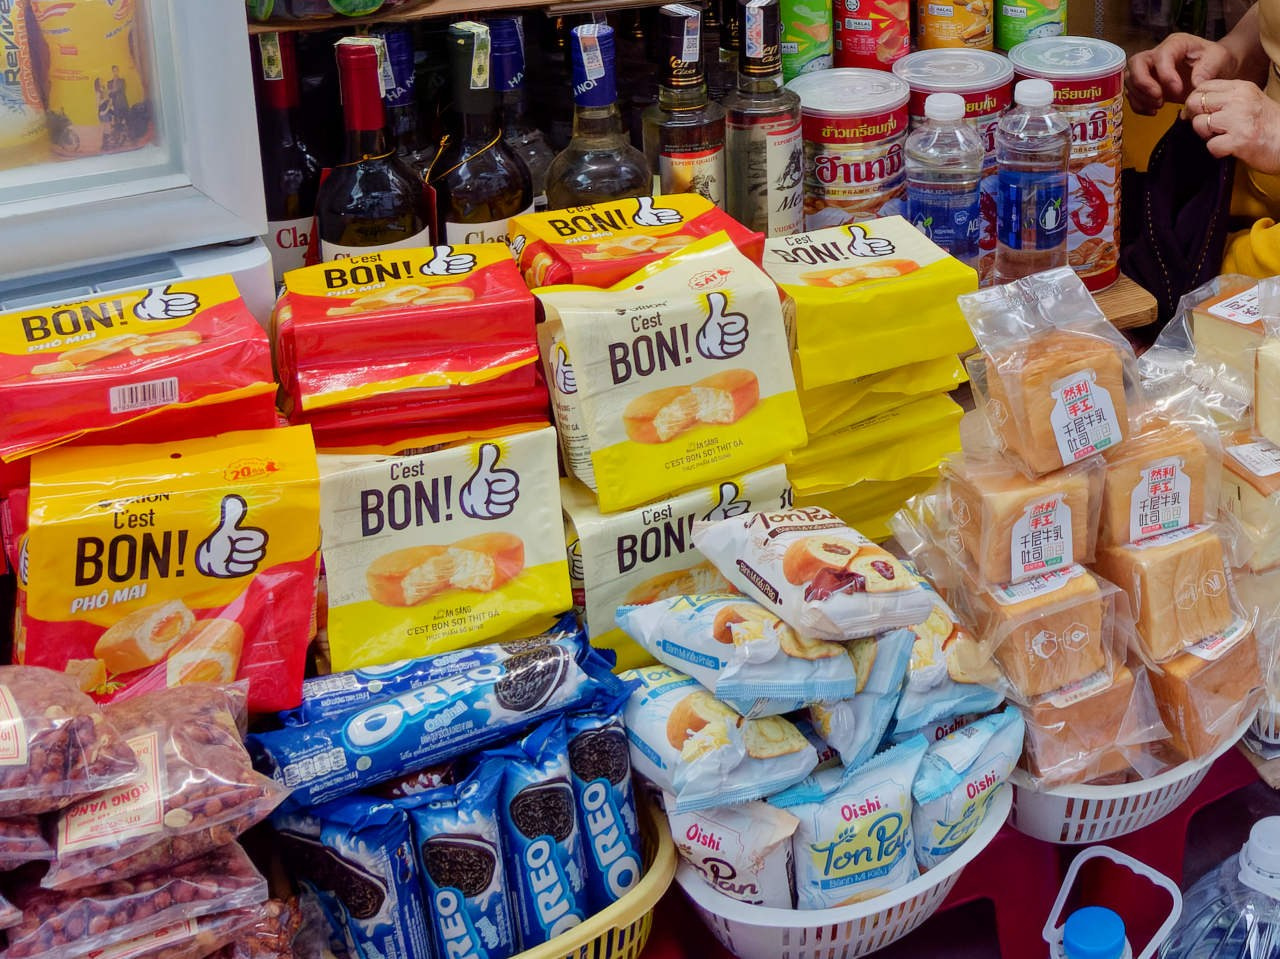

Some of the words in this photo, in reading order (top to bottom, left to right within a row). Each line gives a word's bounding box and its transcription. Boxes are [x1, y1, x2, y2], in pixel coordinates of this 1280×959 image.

[547, 207, 633, 237] BON!
[772, 241, 849, 266] BON!
[784, 233, 814, 248] C'est
[324, 255, 413, 289] BON!
[21, 299, 129, 342] BON!
[631, 312, 662, 334] C'est
[65, 331, 96, 346] MAI
[608, 323, 694, 385] BON!
[1069, 399, 1093, 416] 手工
[390, 459, 425, 482] C'est
[686, 453, 702, 464] BON
[1150, 482, 1172, 496] 手工
[113, 508, 155, 531] C'est
[360, 475, 453, 537] BON!
[642, 504, 673, 525] C'est
[617, 513, 696, 574] BON!
[75, 529, 187, 588] BON!
[70, 586, 110, 615] PHÔ
[112, 582, 149, 605] MAI
[347, 662, 507, 748] OREO
[934, 716, 964, 742] Oishi
[966, 774, 998, 800] Oishi
[840, 795, 882, 822] Oishi
[599, 777, 641, 900] OREO
[686, 823, 723, 851] Oishi
[529, 838, 582, 942] OREO
[702, 857, 759, 896] Pan
